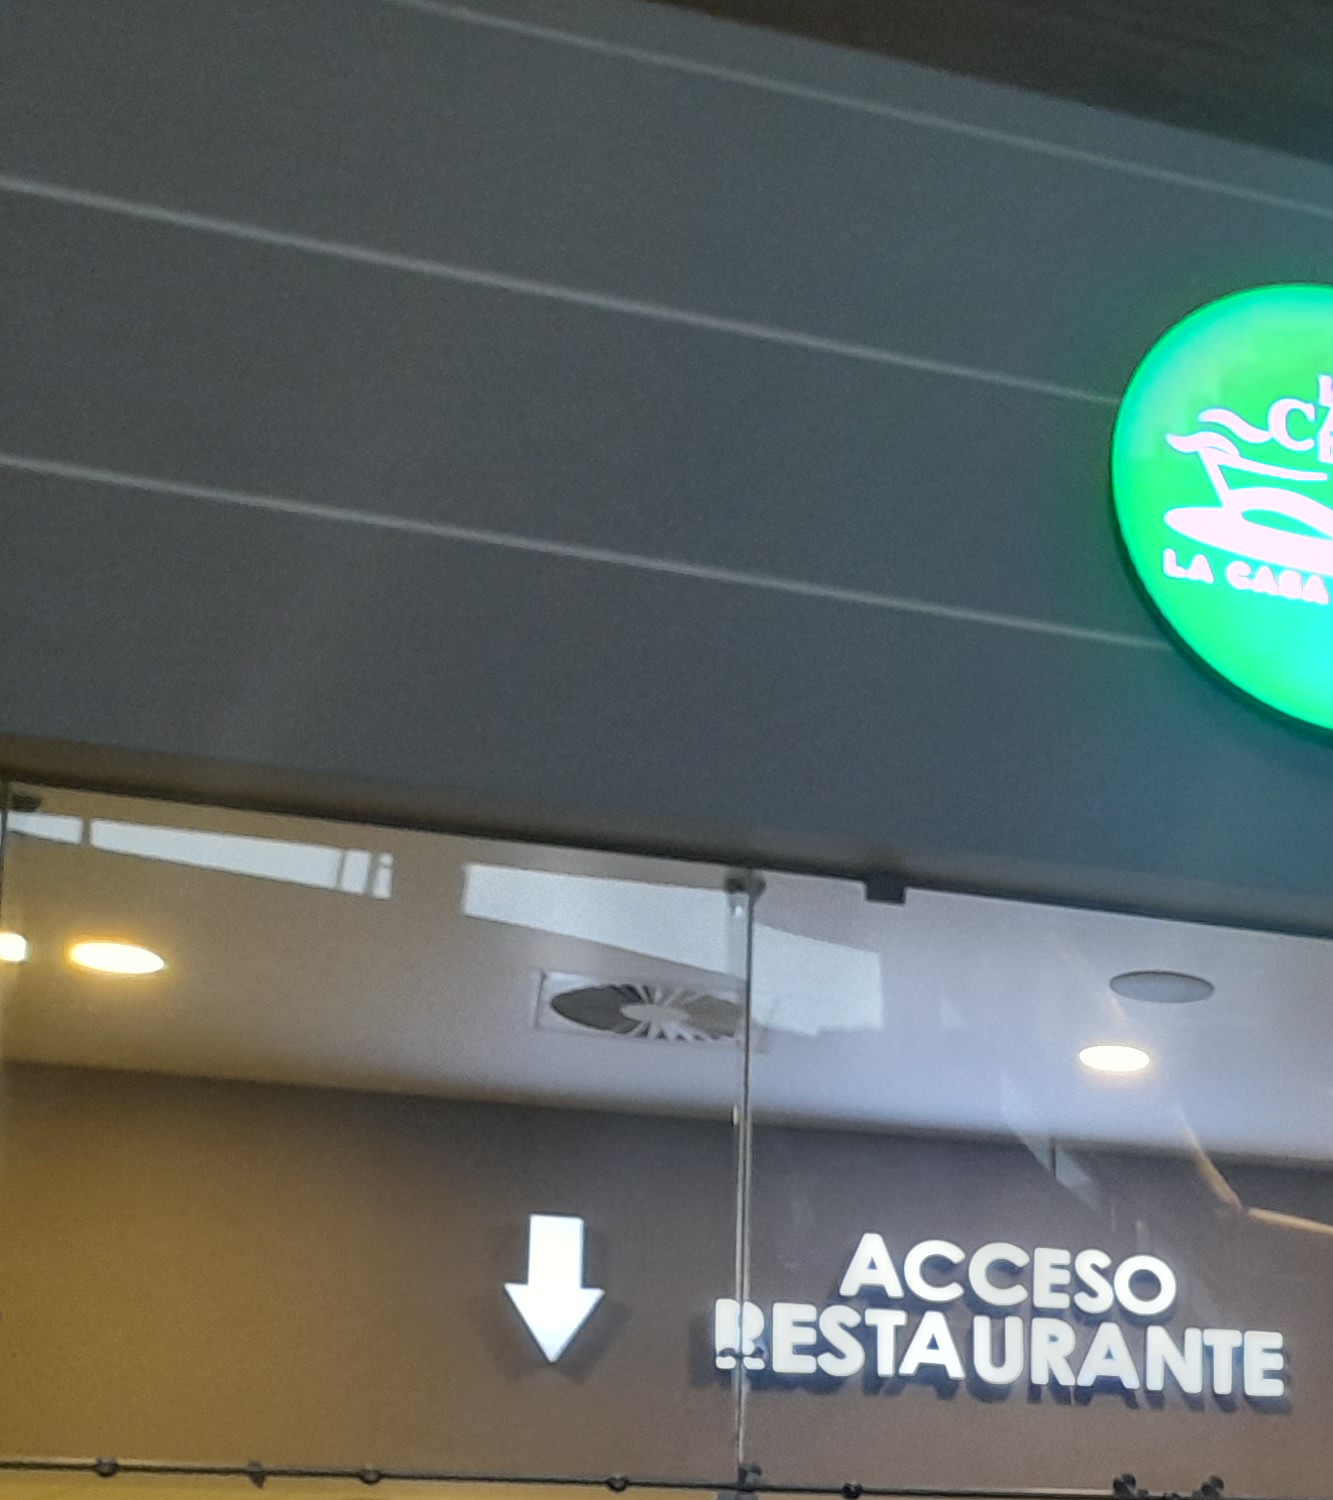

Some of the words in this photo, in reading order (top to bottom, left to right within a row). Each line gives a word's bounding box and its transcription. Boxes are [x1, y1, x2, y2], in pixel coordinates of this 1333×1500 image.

[1163, 548, 1214, 584] LA
[1225, 561, 1329, 605] CASA
[839, 1232, 1177, 1316] ACCESO
[714, 1298, 1286, 1397] RESTAURANTE
